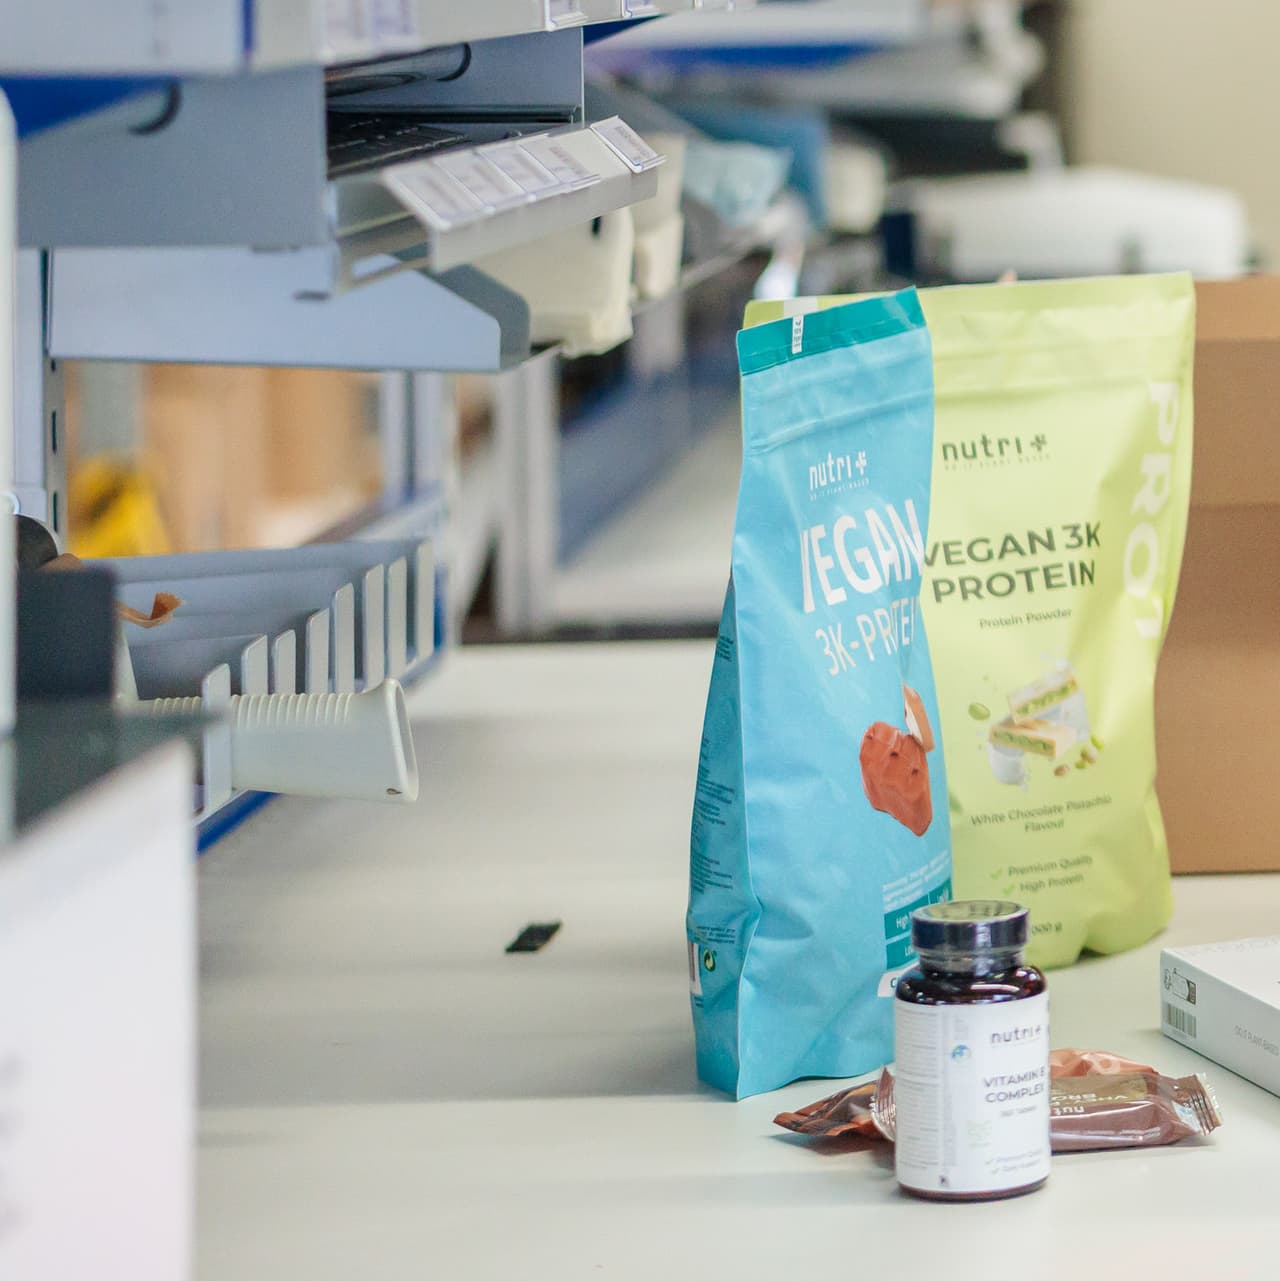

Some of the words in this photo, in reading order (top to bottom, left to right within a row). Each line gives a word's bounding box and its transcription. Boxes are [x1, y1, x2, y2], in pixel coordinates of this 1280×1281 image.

[922, 527, 1056, 568] VEGAN
[1062, 521, 1101, 550] 3K
[932, 560, 1096, 603] PROTEIN
[979, 615, 1023, 630] Protein
[1026, 608, 1072, 624] Powder
[970, 813, 1005, 827] White
[1008, 805, 1062, 821] Chocolate
[1024, 820, 1065, 833] Flavour
[1008, 860, 1057, 877] Premium
[1020, 879, 1046, 893] High
[983, 1069, 1038, 1088] VITAMIN
